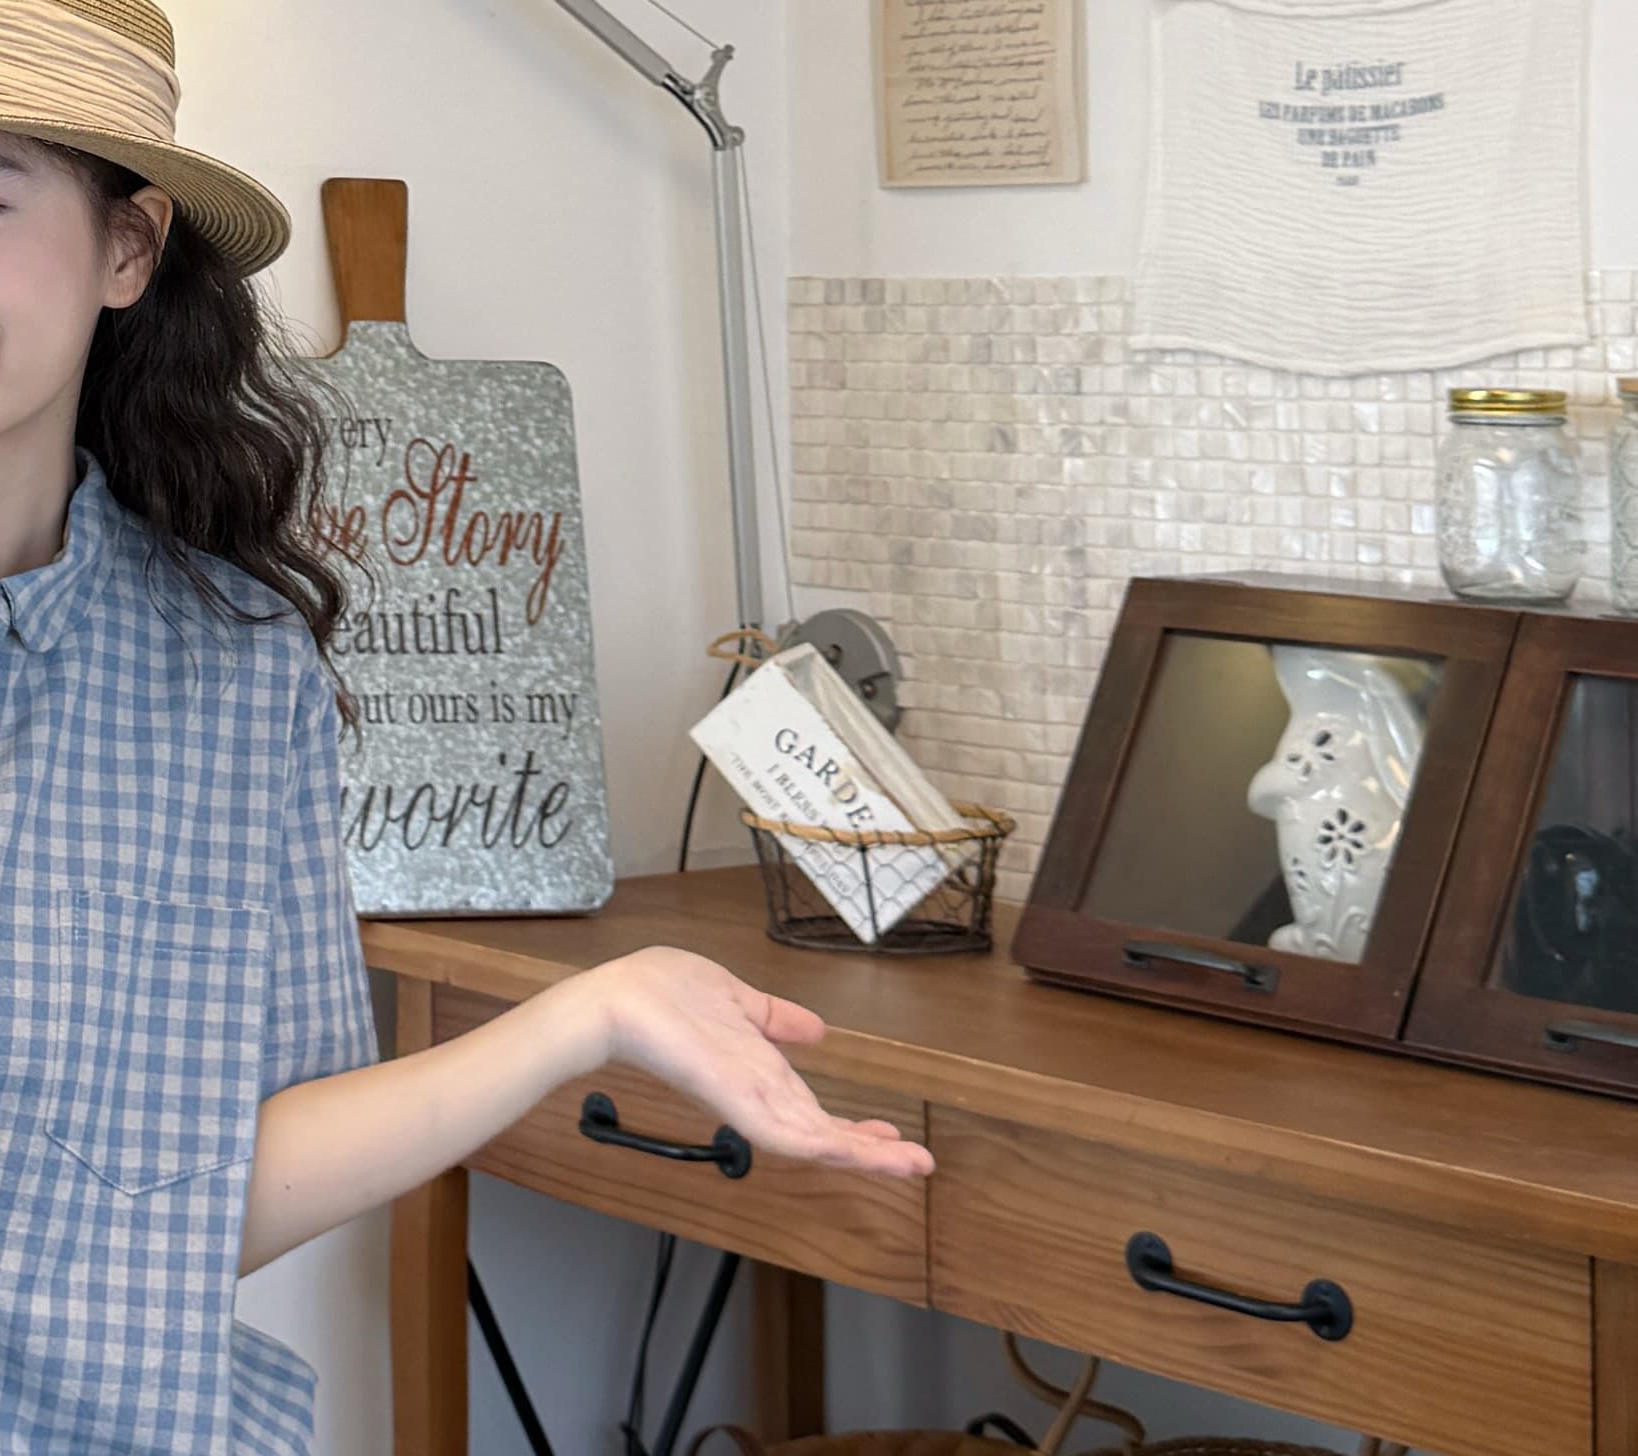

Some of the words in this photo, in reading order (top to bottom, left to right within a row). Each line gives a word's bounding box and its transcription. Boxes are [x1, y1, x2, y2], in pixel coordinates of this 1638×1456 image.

[317, 416, 393, 467] very
[382, 438, 564, 626] Story
[330, 587, 505, 655] eautiful
[354, 688, 396, 724] ut
[408, 691, 480, 724] ours
[491, 680, 515, 724] is
[526, 691, 578, 740] my
[339, 751, 573, 851] vorite
[774, 728, 875, 829] GARDE
